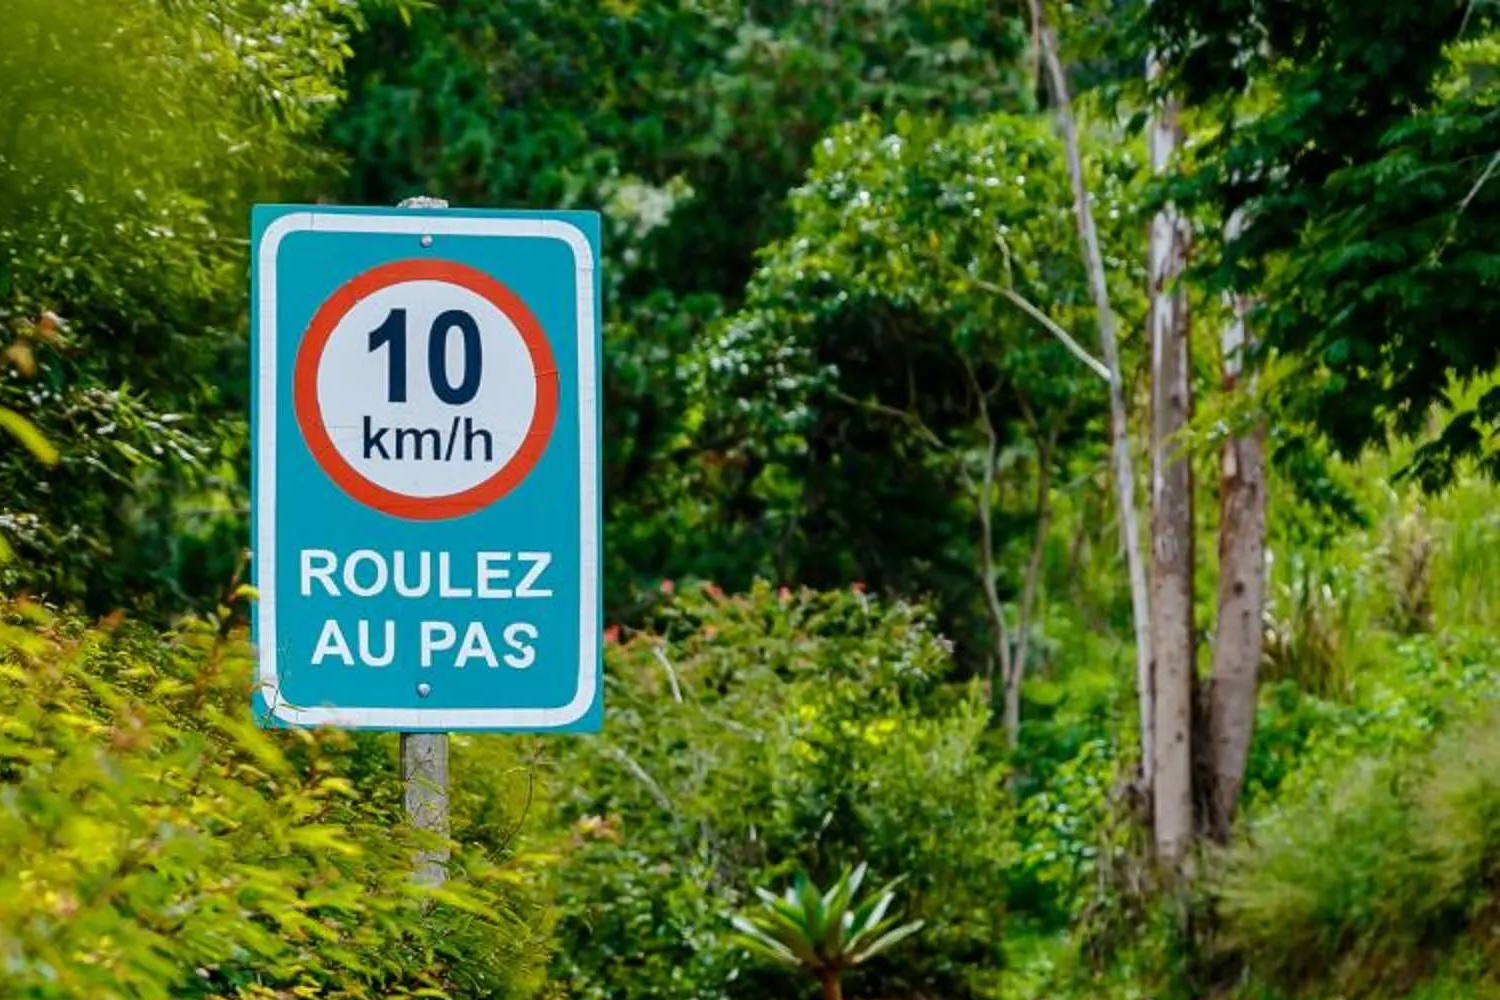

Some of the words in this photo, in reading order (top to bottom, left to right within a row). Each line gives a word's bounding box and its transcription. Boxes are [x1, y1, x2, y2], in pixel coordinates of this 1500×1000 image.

[367, 307, 483, 406] 10
[362, 415, 493, 462] km/h
[300, 549, 553, 599] ROULEZ
[311, 619, 395, 667] AU
[420, 621, 538, 669] PAS
